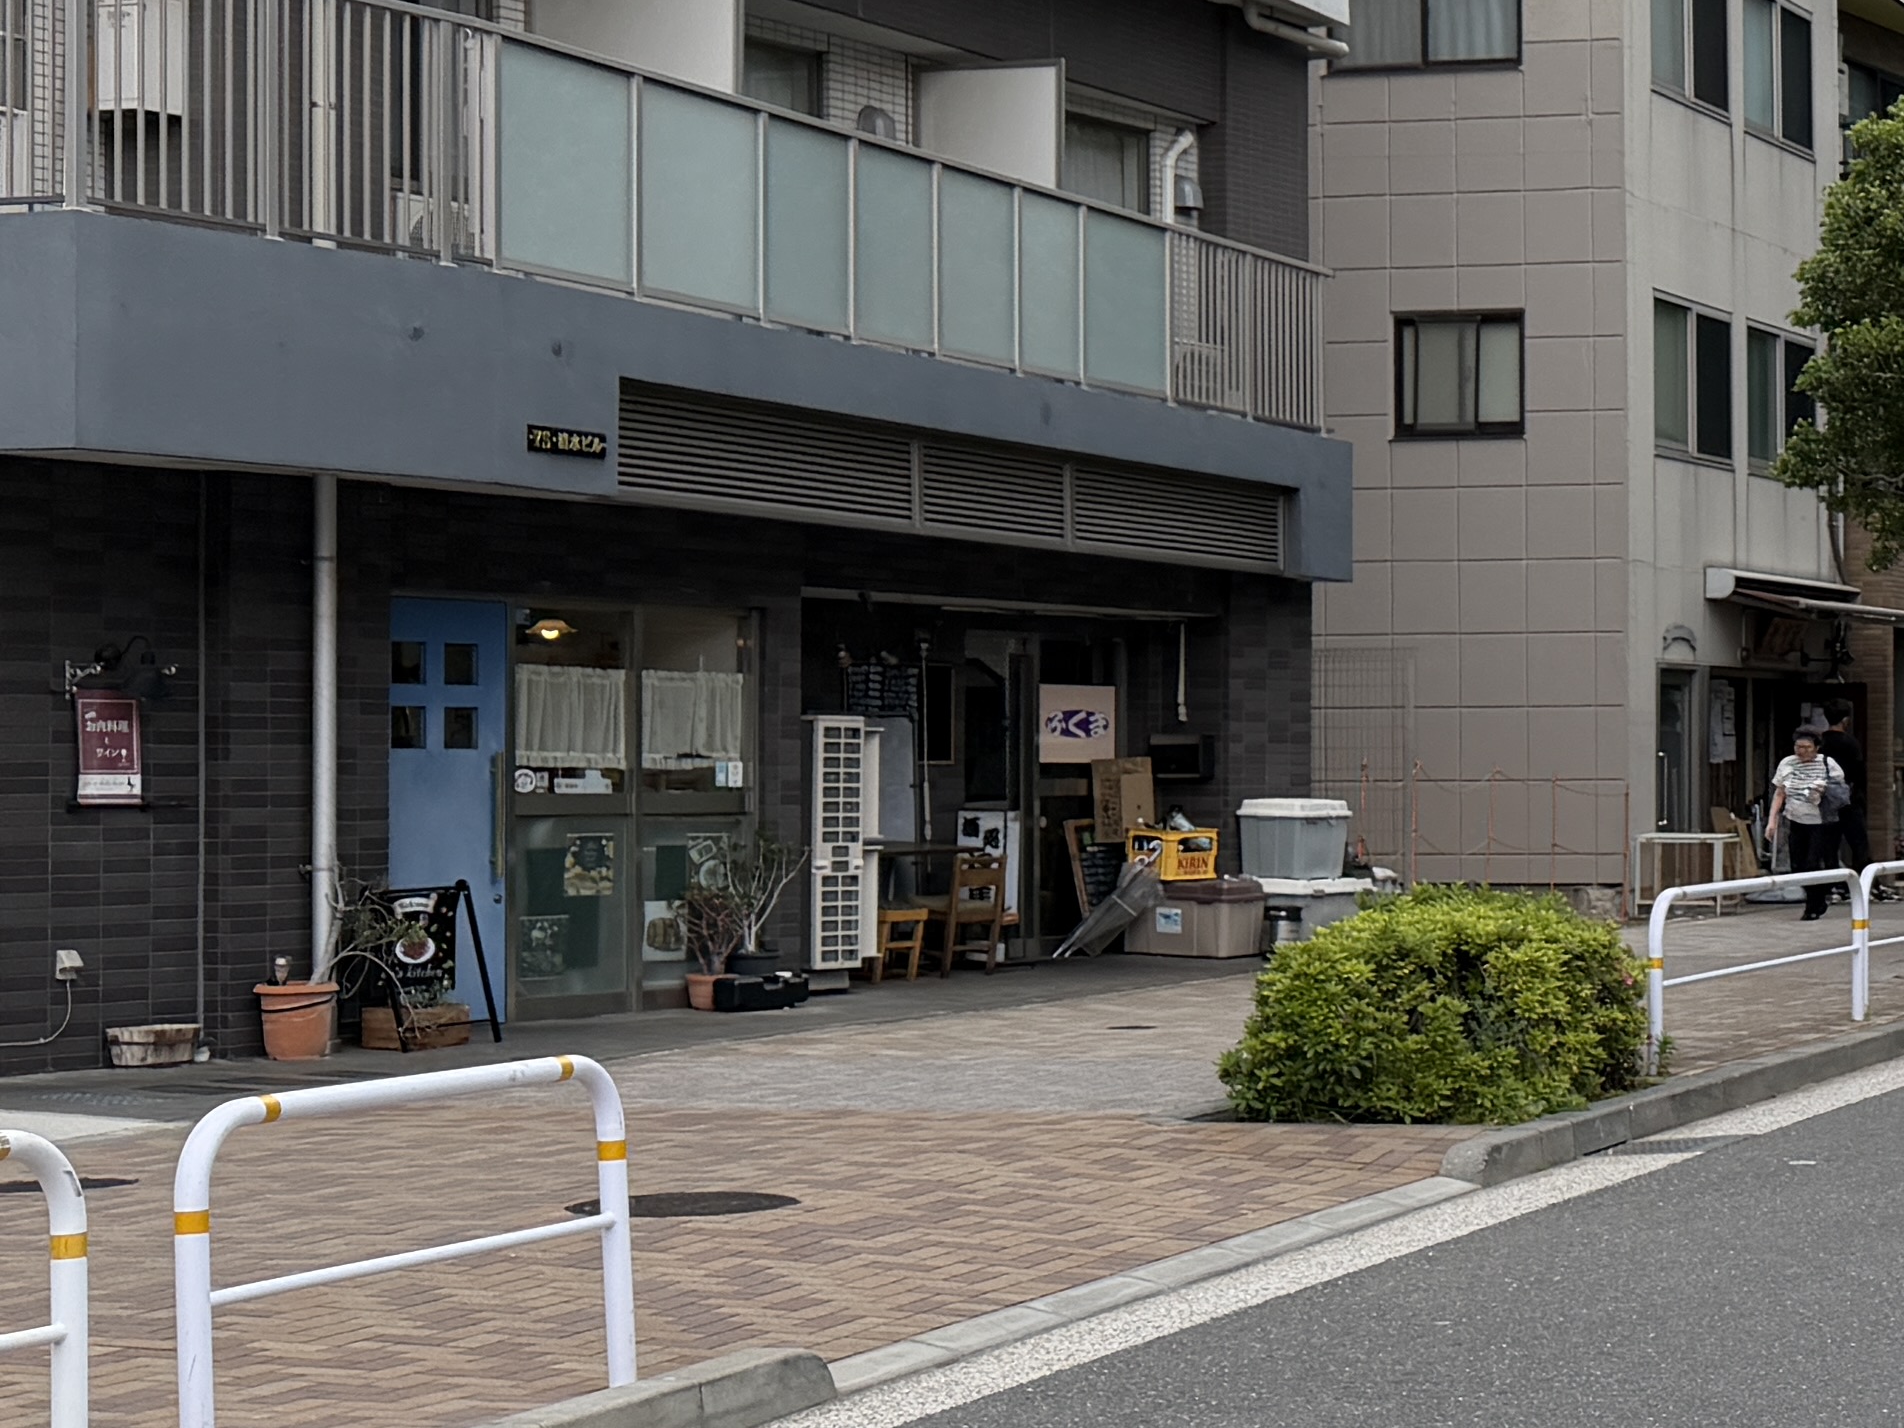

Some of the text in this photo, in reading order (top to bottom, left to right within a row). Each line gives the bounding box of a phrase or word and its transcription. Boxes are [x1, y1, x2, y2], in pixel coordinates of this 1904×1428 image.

[96, 748, 120, 758] ワイン
[1177, 855, 1209, 871] KIRIN
